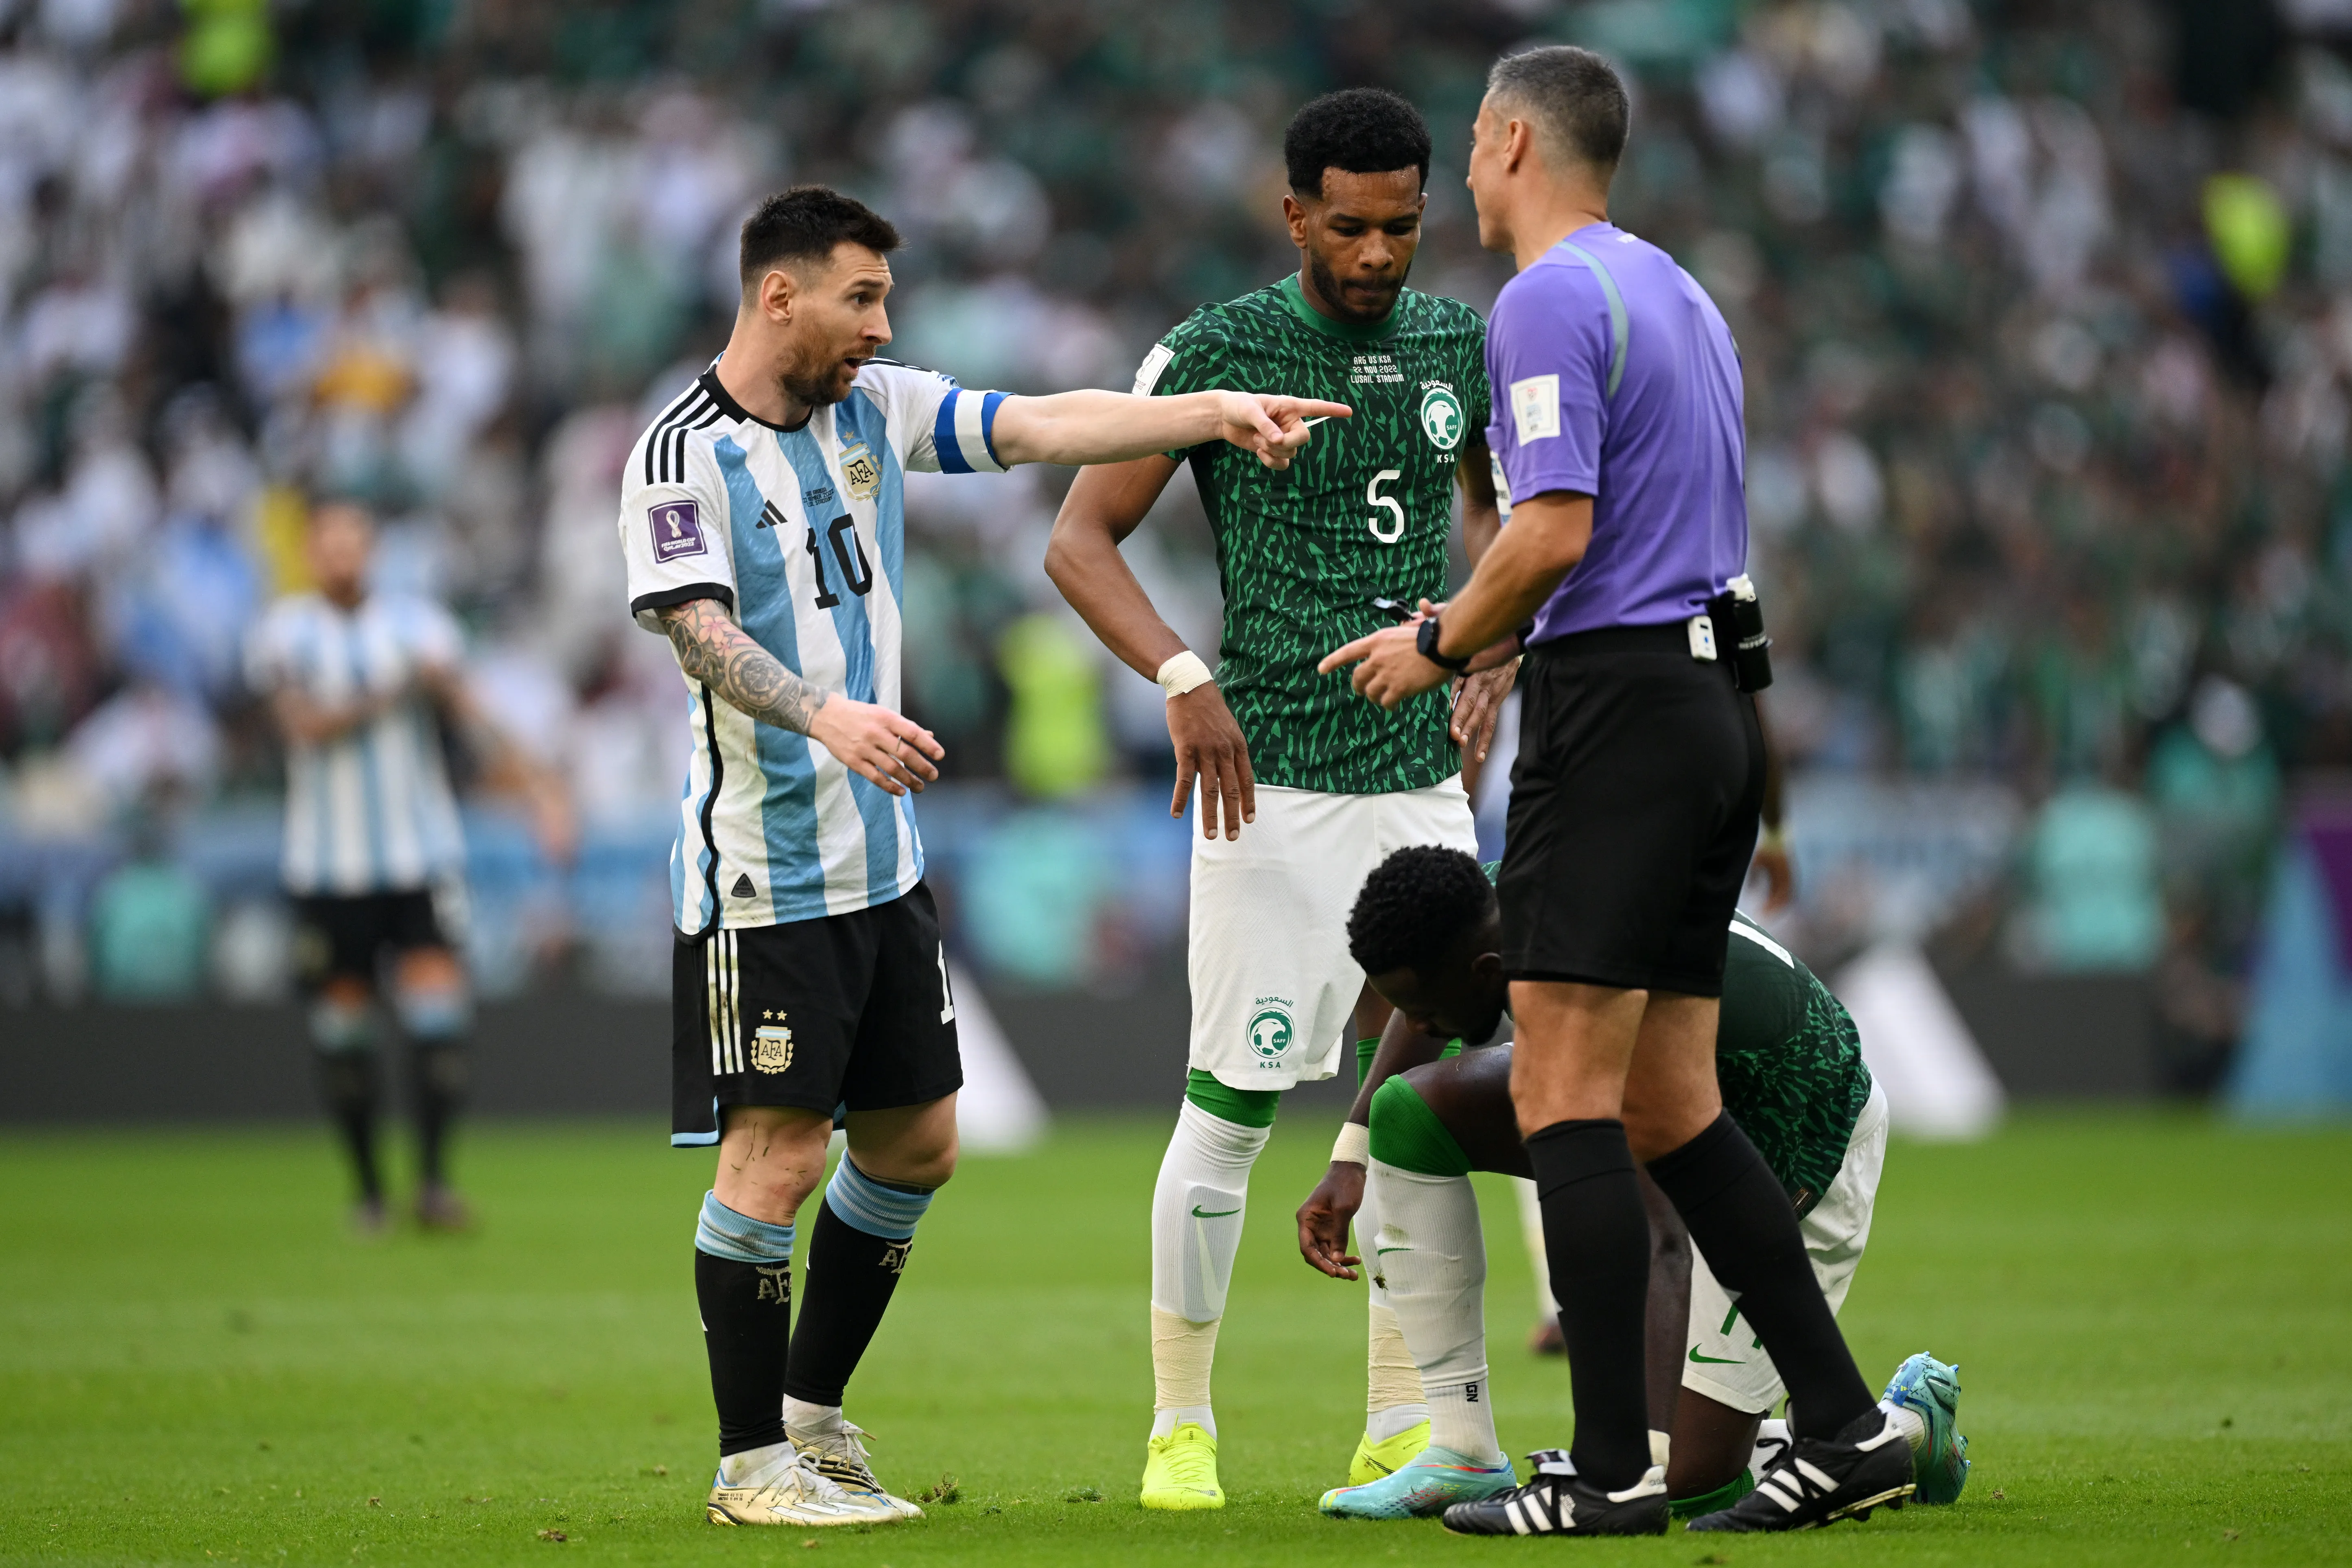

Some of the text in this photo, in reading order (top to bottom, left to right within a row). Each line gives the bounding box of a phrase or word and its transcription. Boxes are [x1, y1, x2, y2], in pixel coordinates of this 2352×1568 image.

[1353, 356, 1366, 365] ARG
[1379, 355, 1392, 363] KSA
[1379, 365, 1397, 373] 2022
[1351, 374, 1404, 383] LUSAIL STADIUM
[1420, 380, 1453, 392] السعودية
[1437, 454, 1455, 463] KSA
[847, 459, 874, 485] AFA
[823, 488, 834, 498] 2022
[1367, 470, 1404, 543] 5
[806, 513, 873, 610] 10
[1255, 996, 1294, 1008] السعودية
[761, 1039, 783, 1061] AFA
